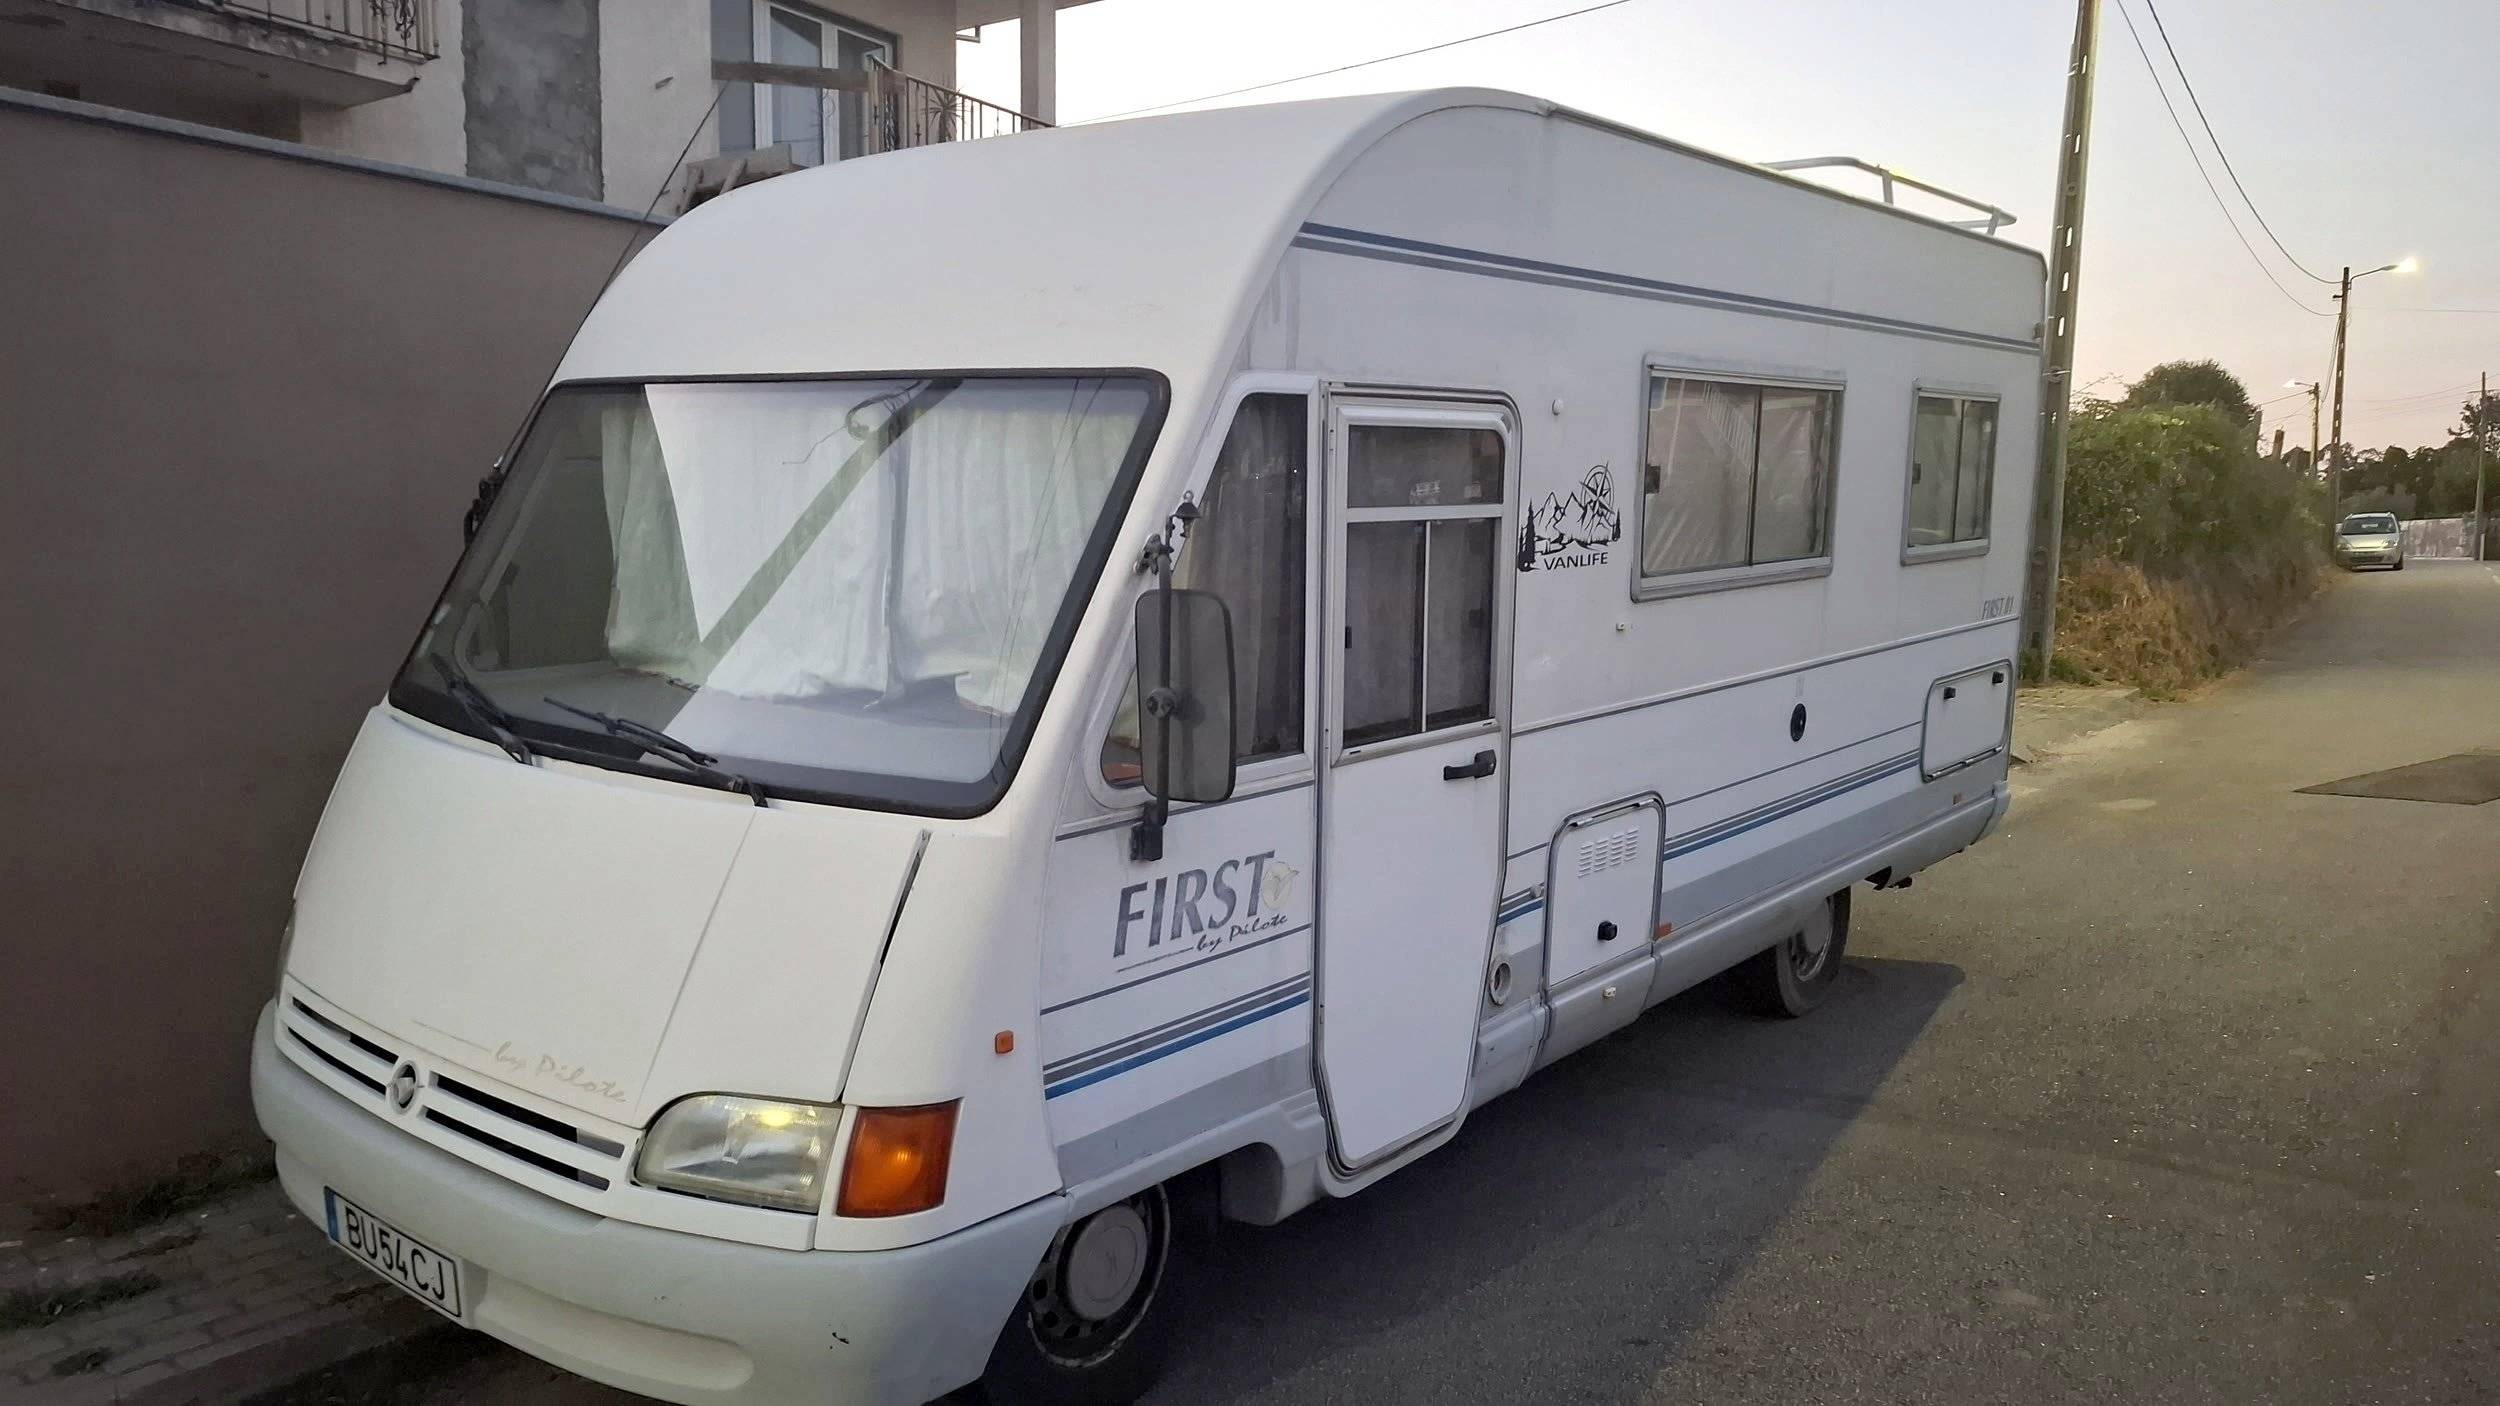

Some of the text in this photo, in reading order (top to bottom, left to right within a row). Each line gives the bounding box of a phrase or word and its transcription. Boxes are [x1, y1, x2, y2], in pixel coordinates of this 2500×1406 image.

[1543, 551, 1609, 571] VANLIFE
[1113, 850, 1276, 958] FIRST
[1196, 913, 1288, 952] by Pilote
[495, 1041, 627, 1102] by Pilote
[345, 1205, 445, 1301] BU54CJ
